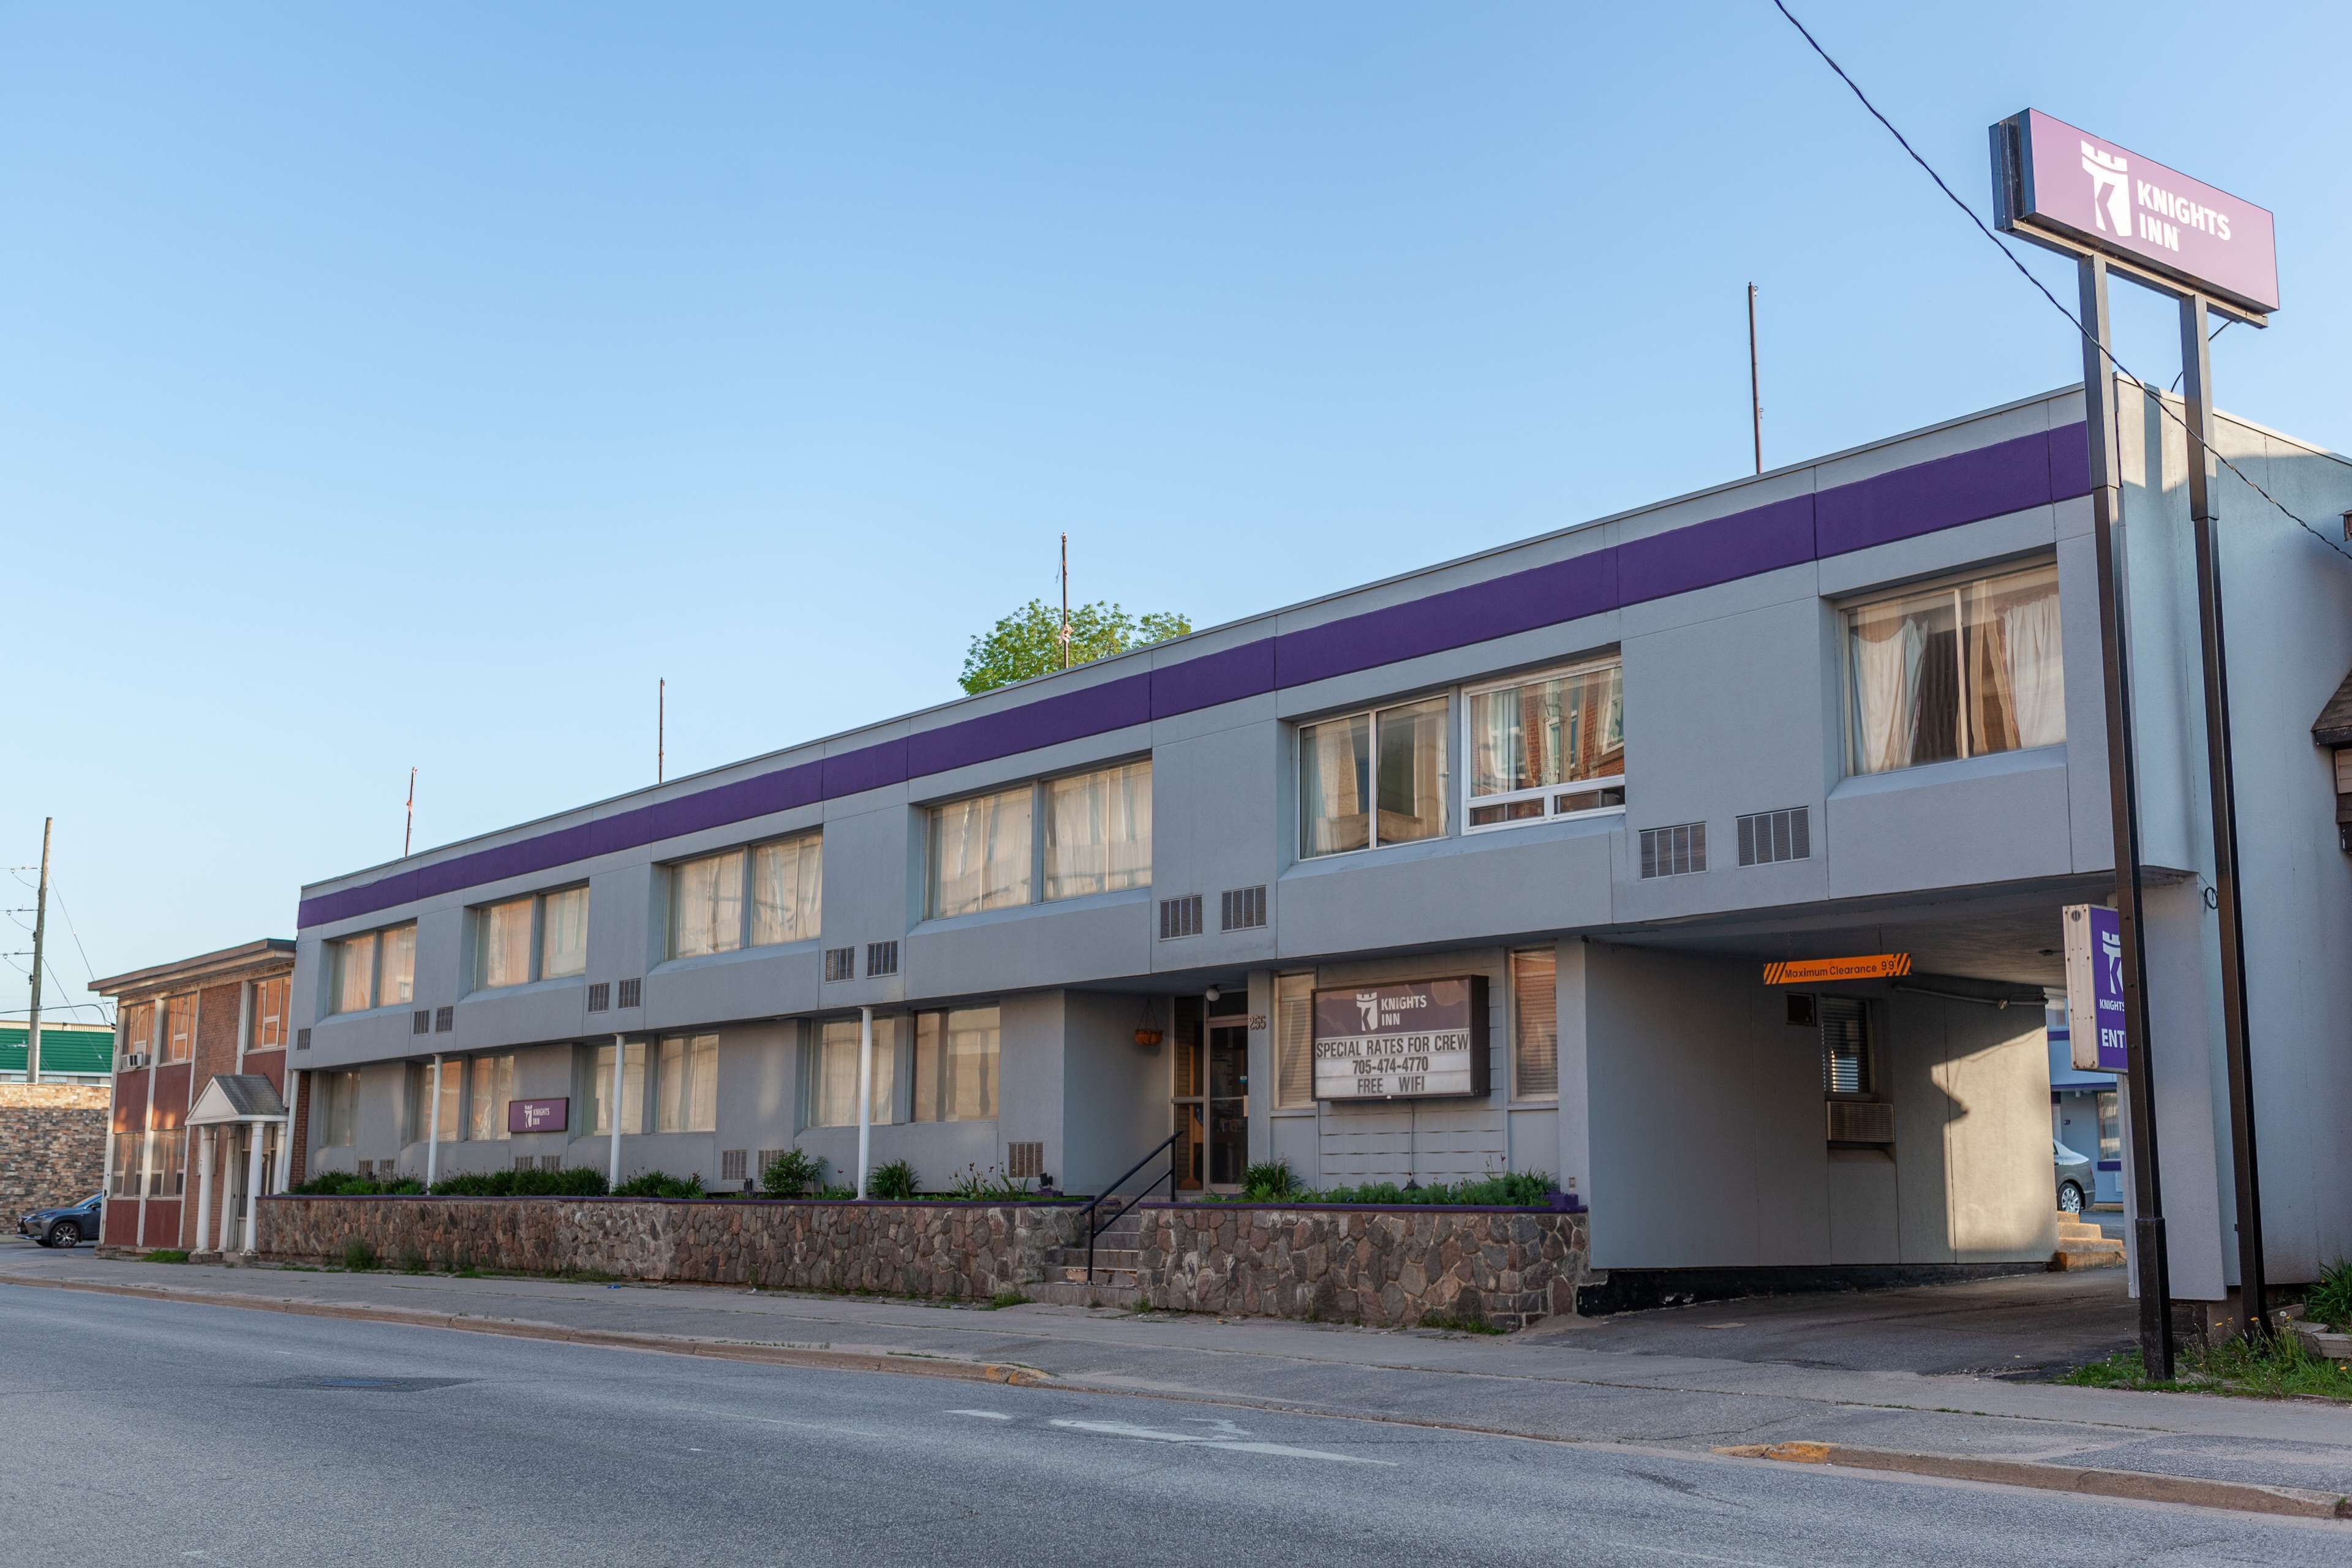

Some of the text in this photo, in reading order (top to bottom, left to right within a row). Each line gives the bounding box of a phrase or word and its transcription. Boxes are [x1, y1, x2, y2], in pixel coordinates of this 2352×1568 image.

[2137, 179, 2231, 241] KNIGHTS
[2139, 212, 2179, 253] INN
[1785, 968, 1828, 978] Maximum
[1830, 965, 1877, 976] Clearance
[1381, 995, 1427, 1011] KNIGHTS
[1249, 1014, 1267, 1030] 255
[1382, 1012, 1400, 1026] INN
[1317, 1033, 1469, 1058] SPECIAL RATES FOR CREW
[1352, 1056, 1428, 1075] 705-474-4770
[1357, 1076, 1425, 1094] FREE WIFI
